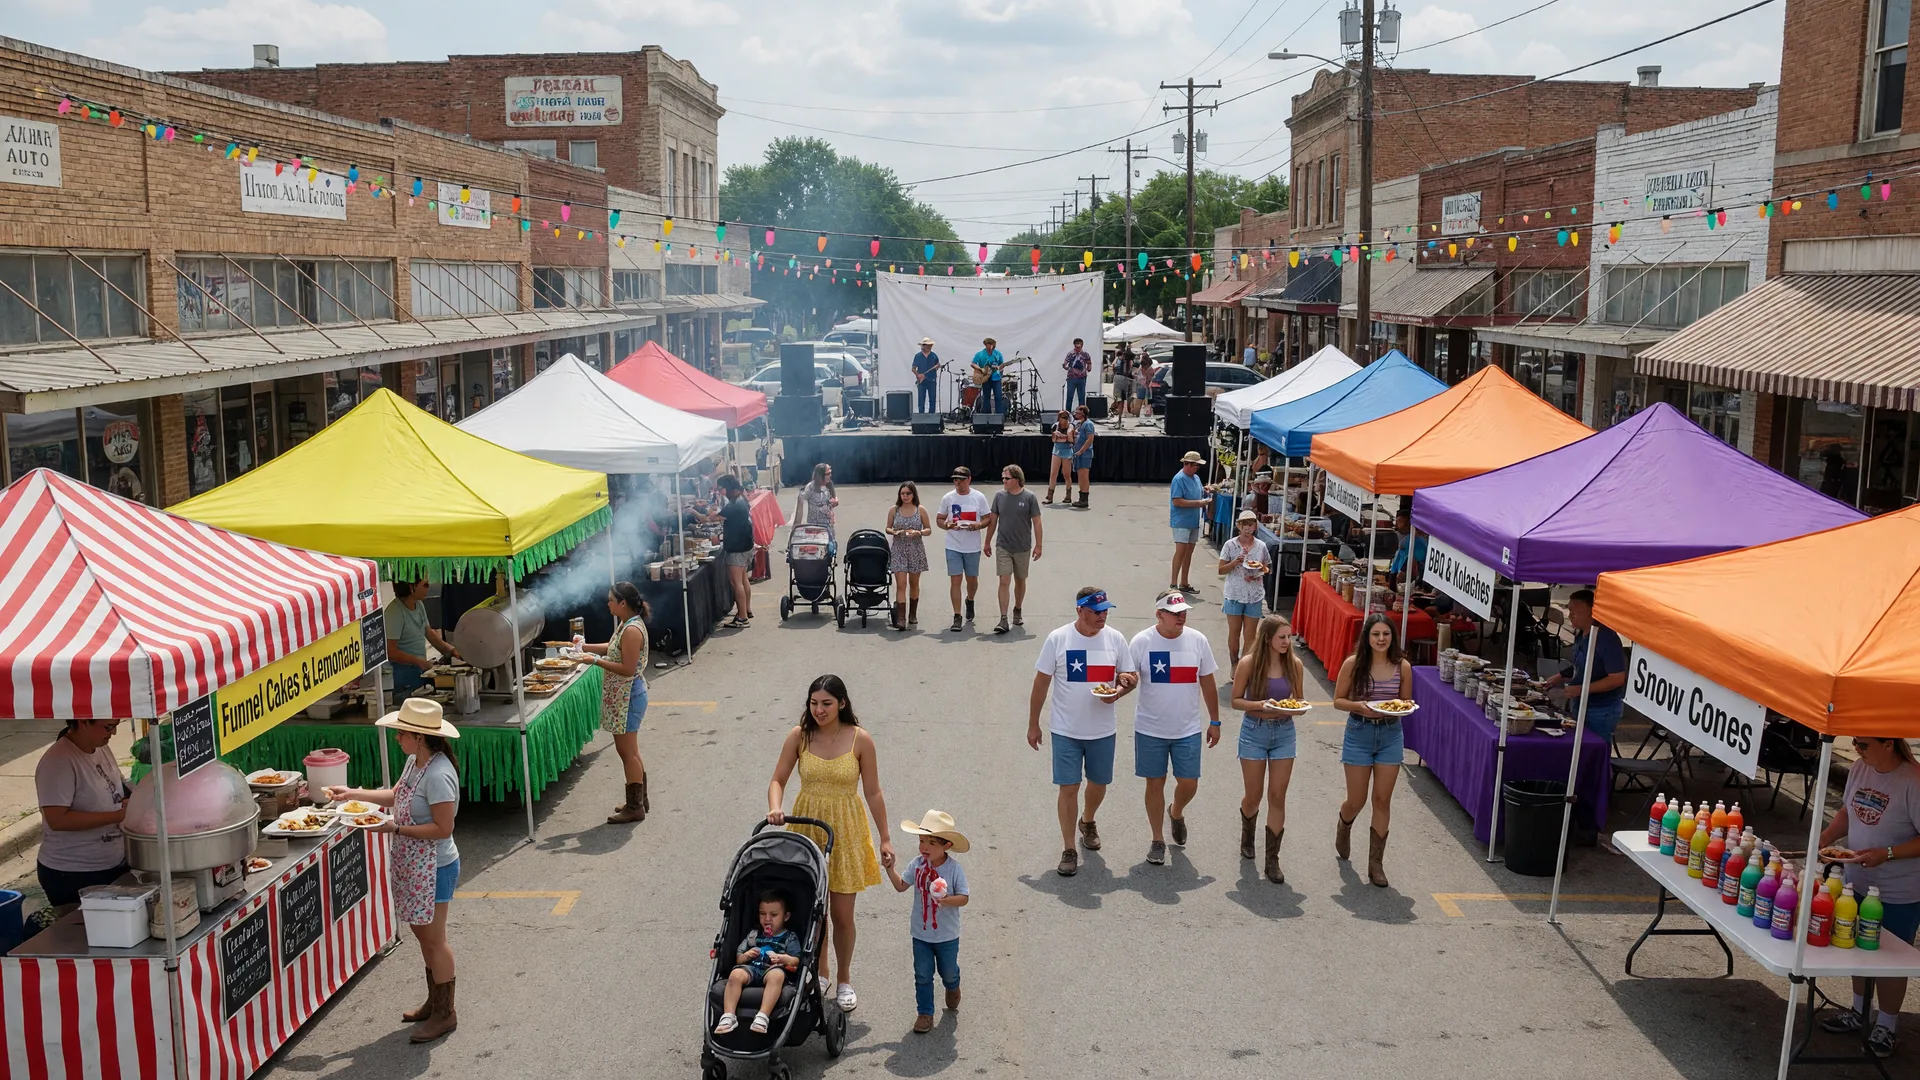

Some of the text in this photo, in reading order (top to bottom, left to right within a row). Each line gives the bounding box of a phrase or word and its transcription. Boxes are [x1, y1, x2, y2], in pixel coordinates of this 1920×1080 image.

[7, 148, 49, 167] AUTO
[1428, 547, 1491, 605] BBQ & Kolaches
[221, 683, 264, 737] Funnel
[266, 673, 300, 712] Cakes
[302, 661, 311, 692] &
[312, 636, 360, 687] Lemonade
[1634, 658, 1753, 755] Snow Cones
